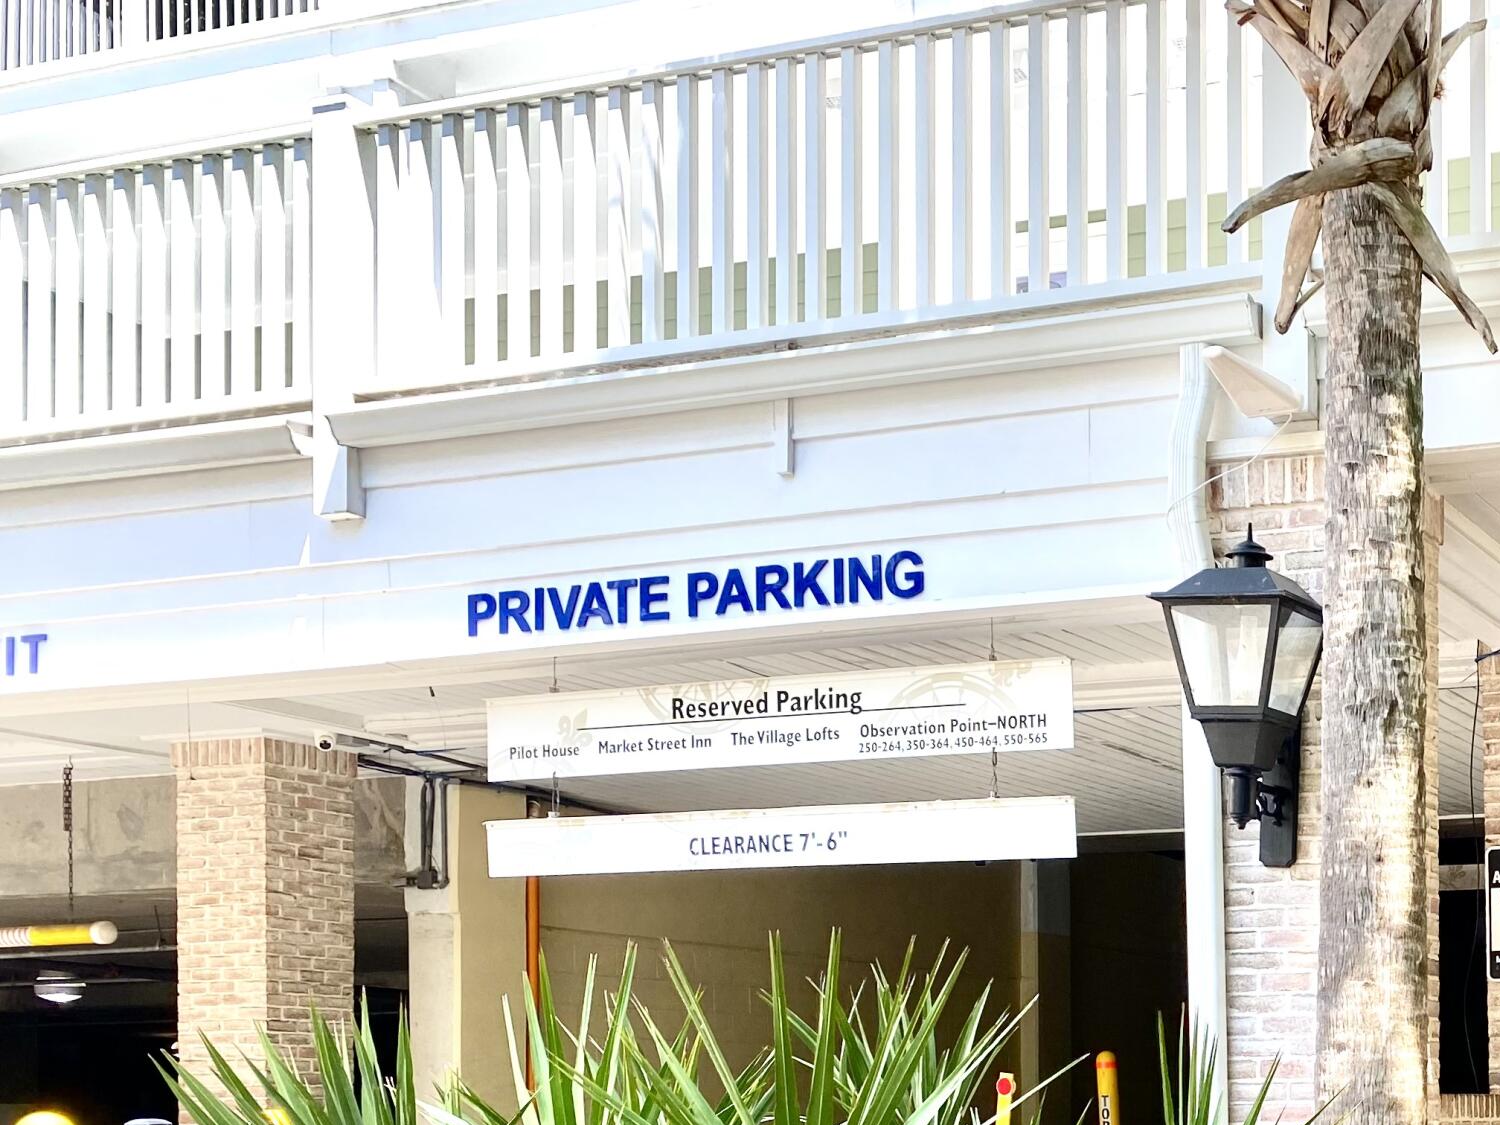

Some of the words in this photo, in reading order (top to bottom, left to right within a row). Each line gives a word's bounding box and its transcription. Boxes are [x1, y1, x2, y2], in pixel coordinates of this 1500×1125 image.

[466, 575, 670, 638] PRIVATE
[687, 550, 925, 618] PARKING
[0, 634, 48, 676] IT
[671, 691, 768, 719] Reserved
[776, 687, 863, 715] Parking
[731, 731, 755, 746] The
[757, 728, 802, 747] Village
[805, 726, 840, 742] Lofts
[860, 720, 946, 738] Observation
[509, 744, 538, 760] Pilot
[542, 744, 580, 758] House
[598, 738, 643, 755] Market
[647, 736, 687, 751] Street
[691, 735, 712, 749] Inn
[689, 833, 793, 855] CLEARANCE
